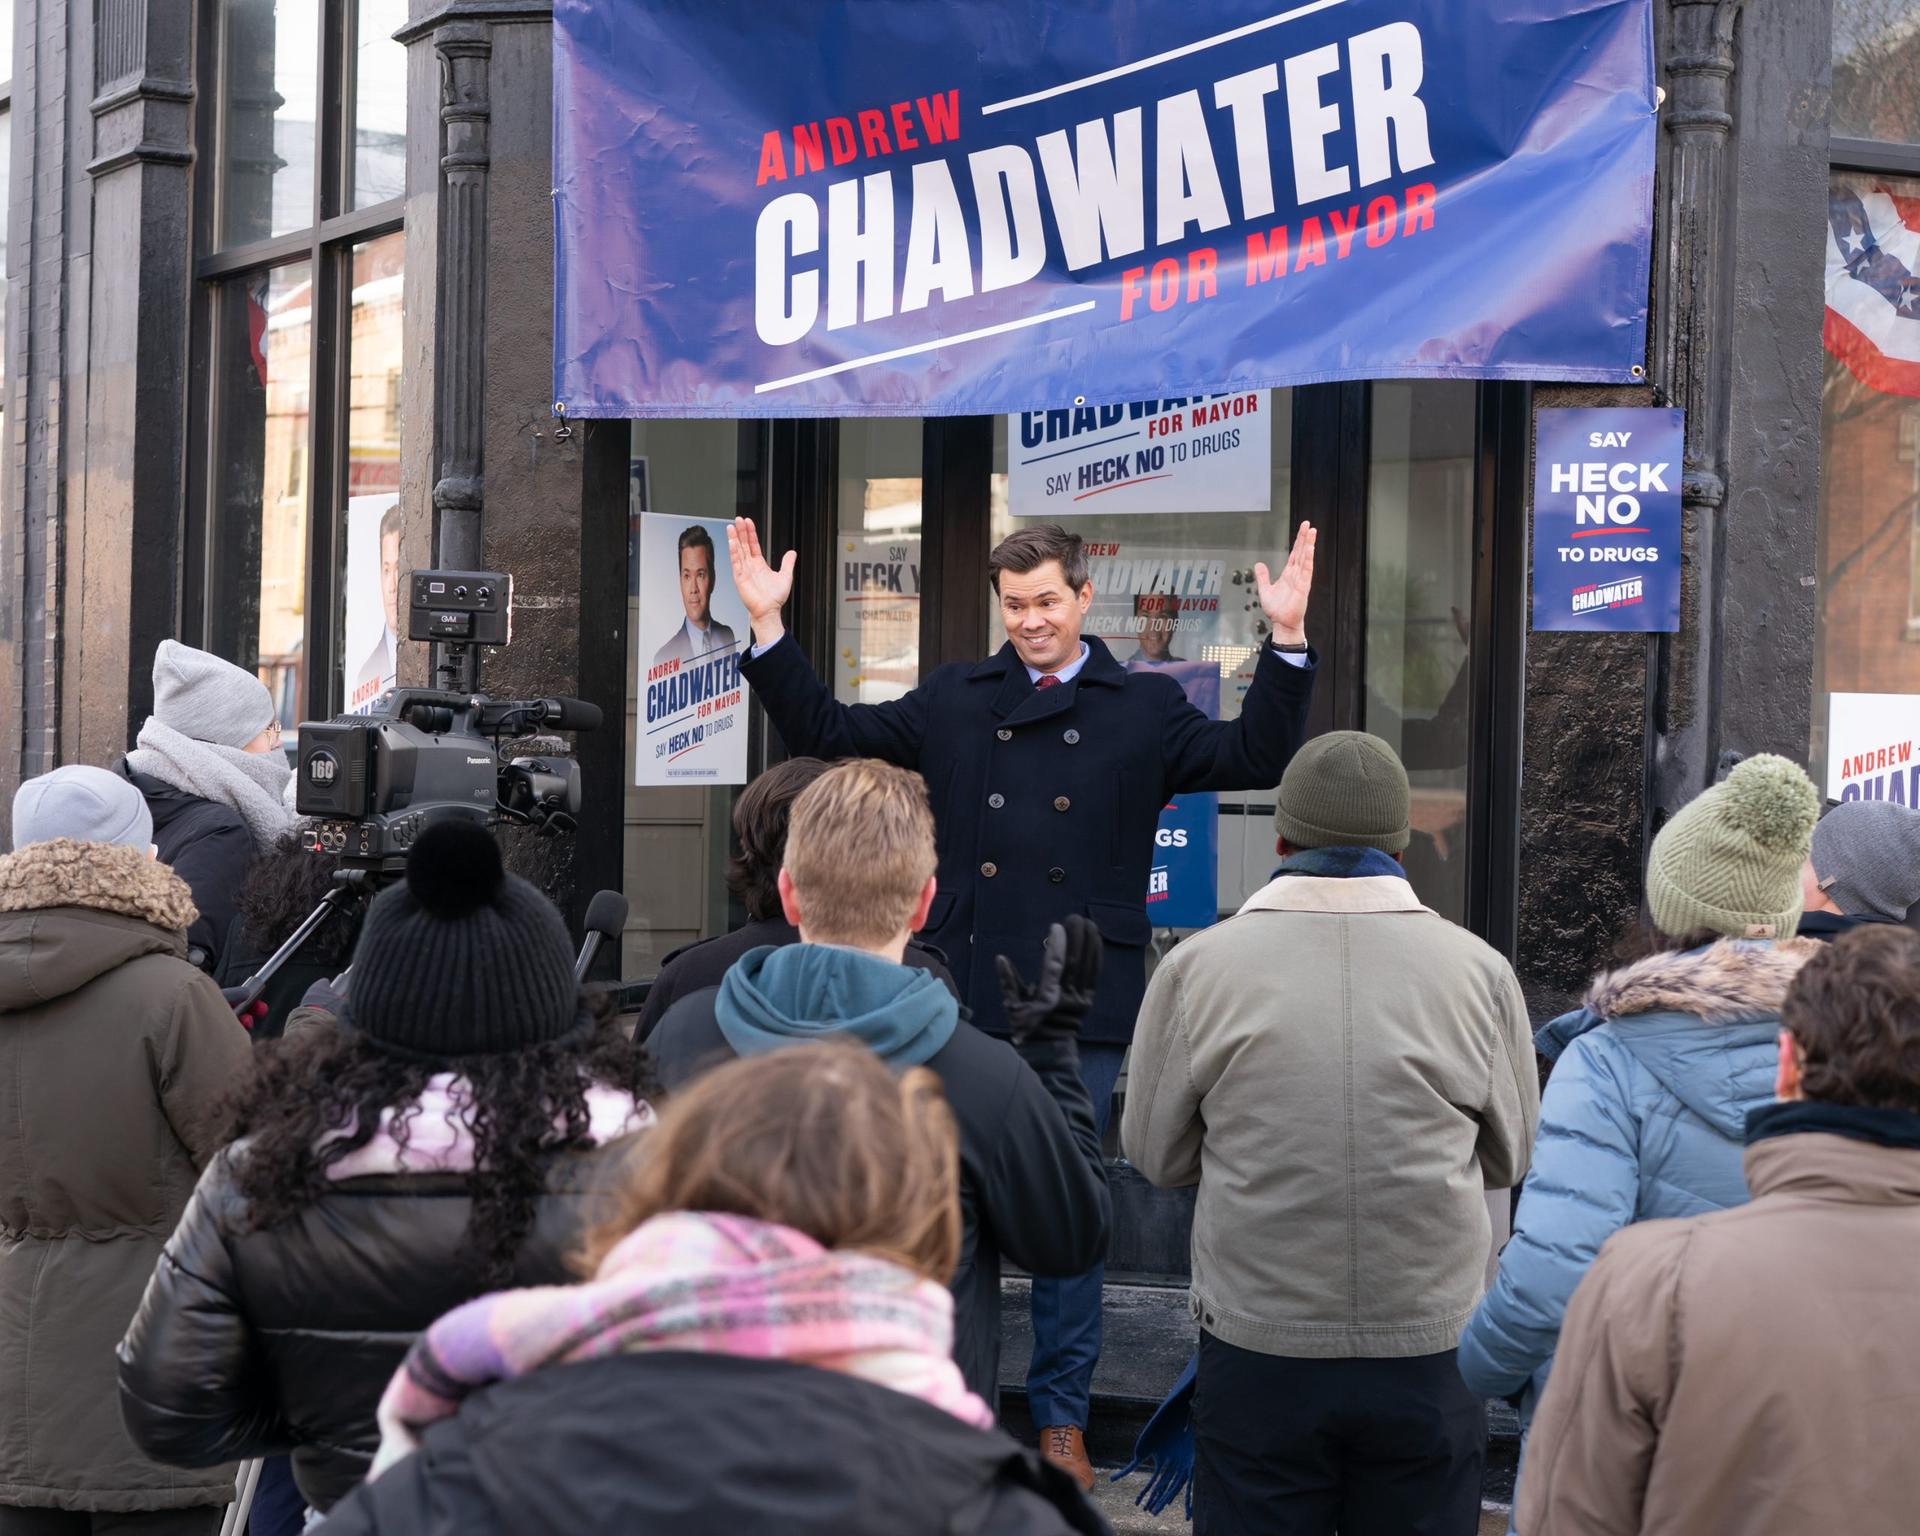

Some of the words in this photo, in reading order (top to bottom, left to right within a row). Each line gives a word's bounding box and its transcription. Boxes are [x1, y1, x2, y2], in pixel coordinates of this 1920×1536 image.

[756, 89, 960, 187] ANDREW
[755, 21, 1436, 347] CHADWATER
[1119, 247, 1218, 322] FOR
[1245, 182, 1437, 287] MAYOR
[1148, 414, 1184, 440] FOR
[1192, 394, 1258, 428] MAYOR
[1589, 432, 1632, 448] SAY
[1046, 472, 1072, 496] SAY
[1077, 454, 1130, 490] HECK
[1136, 446, 1165, 475] NO
[1170, 443, 1187, 464] TO
[1192, 428, 1241, 458] DRUGS
[1551, 462, 1669, 493] HECK
[1576, 494, 1641, 525] NO
[889, 546, 907, 562] SAY
[1082, 543, 1120, 557] REW
[1558, 547, 1584, 562] TO
[1590, 547, 1659, 562] DRUGS
[844, 562, 903, 593] HECK
[1088, 559, 1227, 596] ADWATER
[1138, 598, 1166, 612] FOR
[1169, 598, 1219, 612] MAYOR
[1572, 580, 1643, 611] CHADWATER
[1084, 615, 1122, 633] HECK
[1124, 616, 1148, 634] NO
[1151, 618, 1163, 632] TO
[1165, 617, 1203, 632] DRUGS
[648, 656, 681, 682] ANDREW
[647, 651, 741, 723] CHADWATER
[697, 702, 712, 719] FOR
[715, 690, 741, 713] MAYOR
[655, 742, 667, 759] SAY
[668, 729, 691, 754] HECK
[692, 724, 704, 745] NO
[705, 723, 713, 737] TO
[714, 714, 734, 734] DRUGS
[311, 760, 334, 779] 160
[1841, 740, 1912, 780] ANDREW
